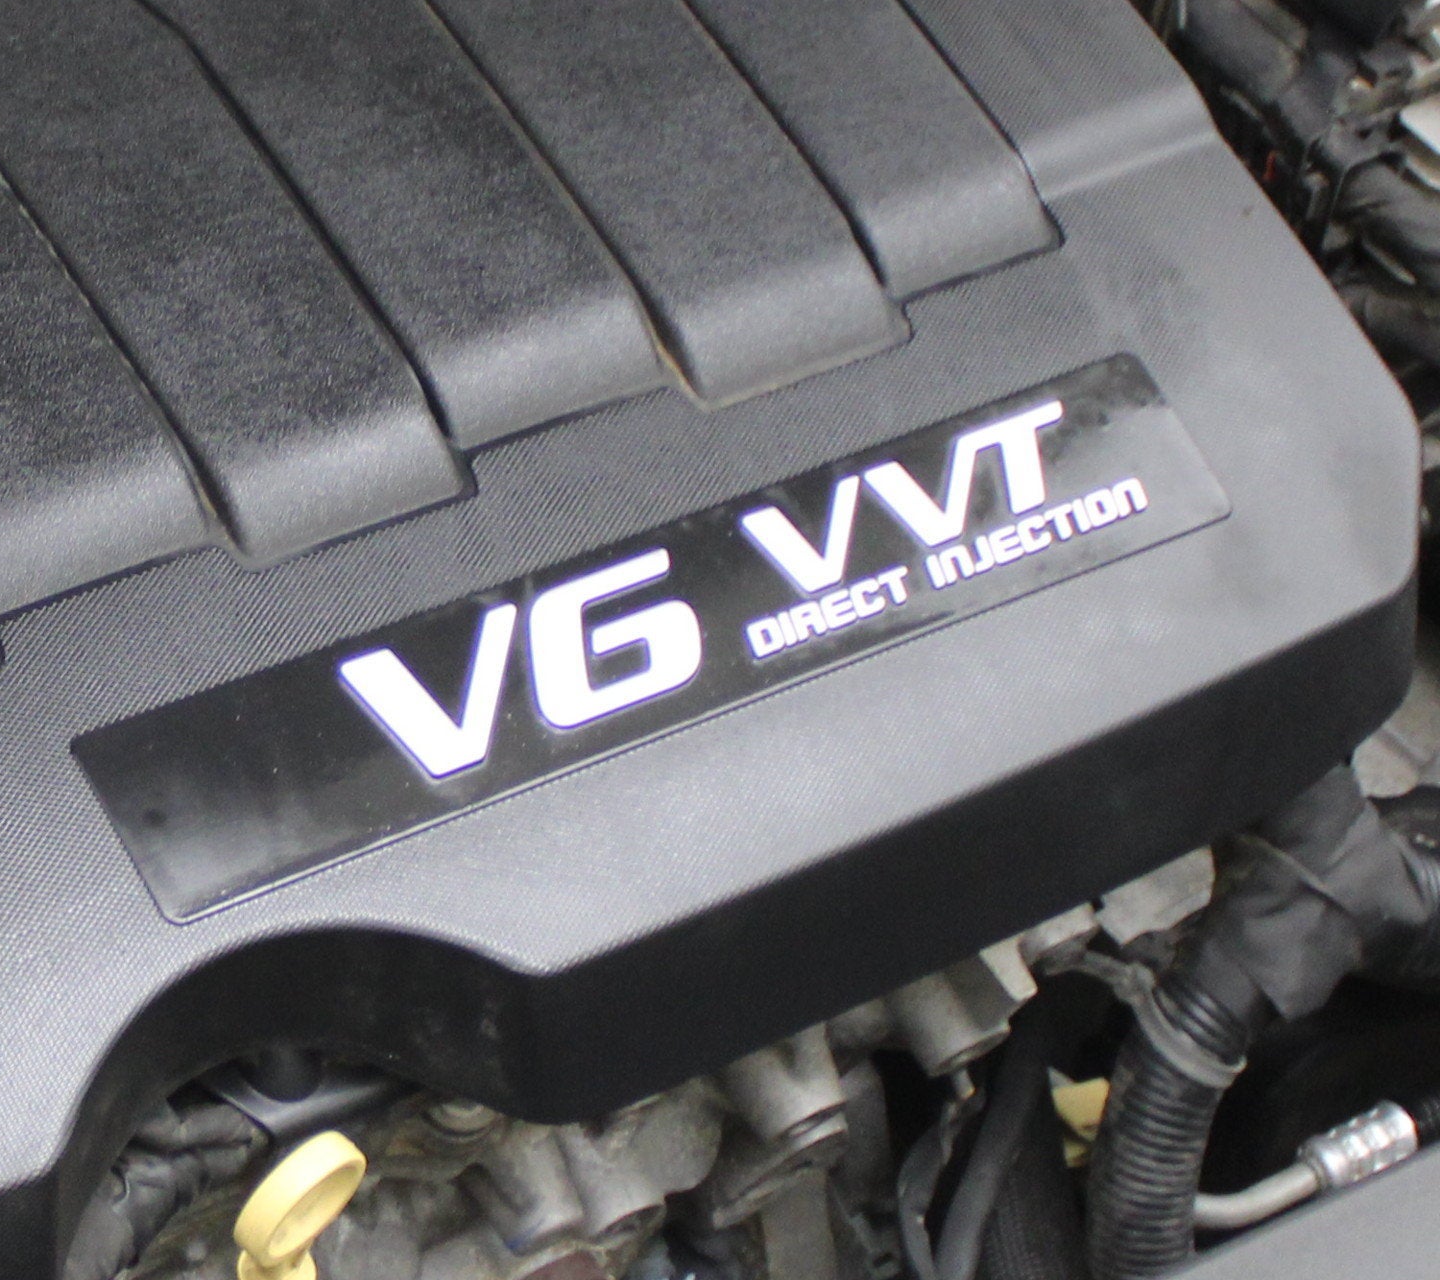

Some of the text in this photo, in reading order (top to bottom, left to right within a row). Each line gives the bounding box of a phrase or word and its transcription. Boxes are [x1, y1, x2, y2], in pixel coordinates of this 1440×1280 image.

[339, 400, 1063, 778] V6 VVT
[745, 477, 1148, 660] DIRECT INJECTION
